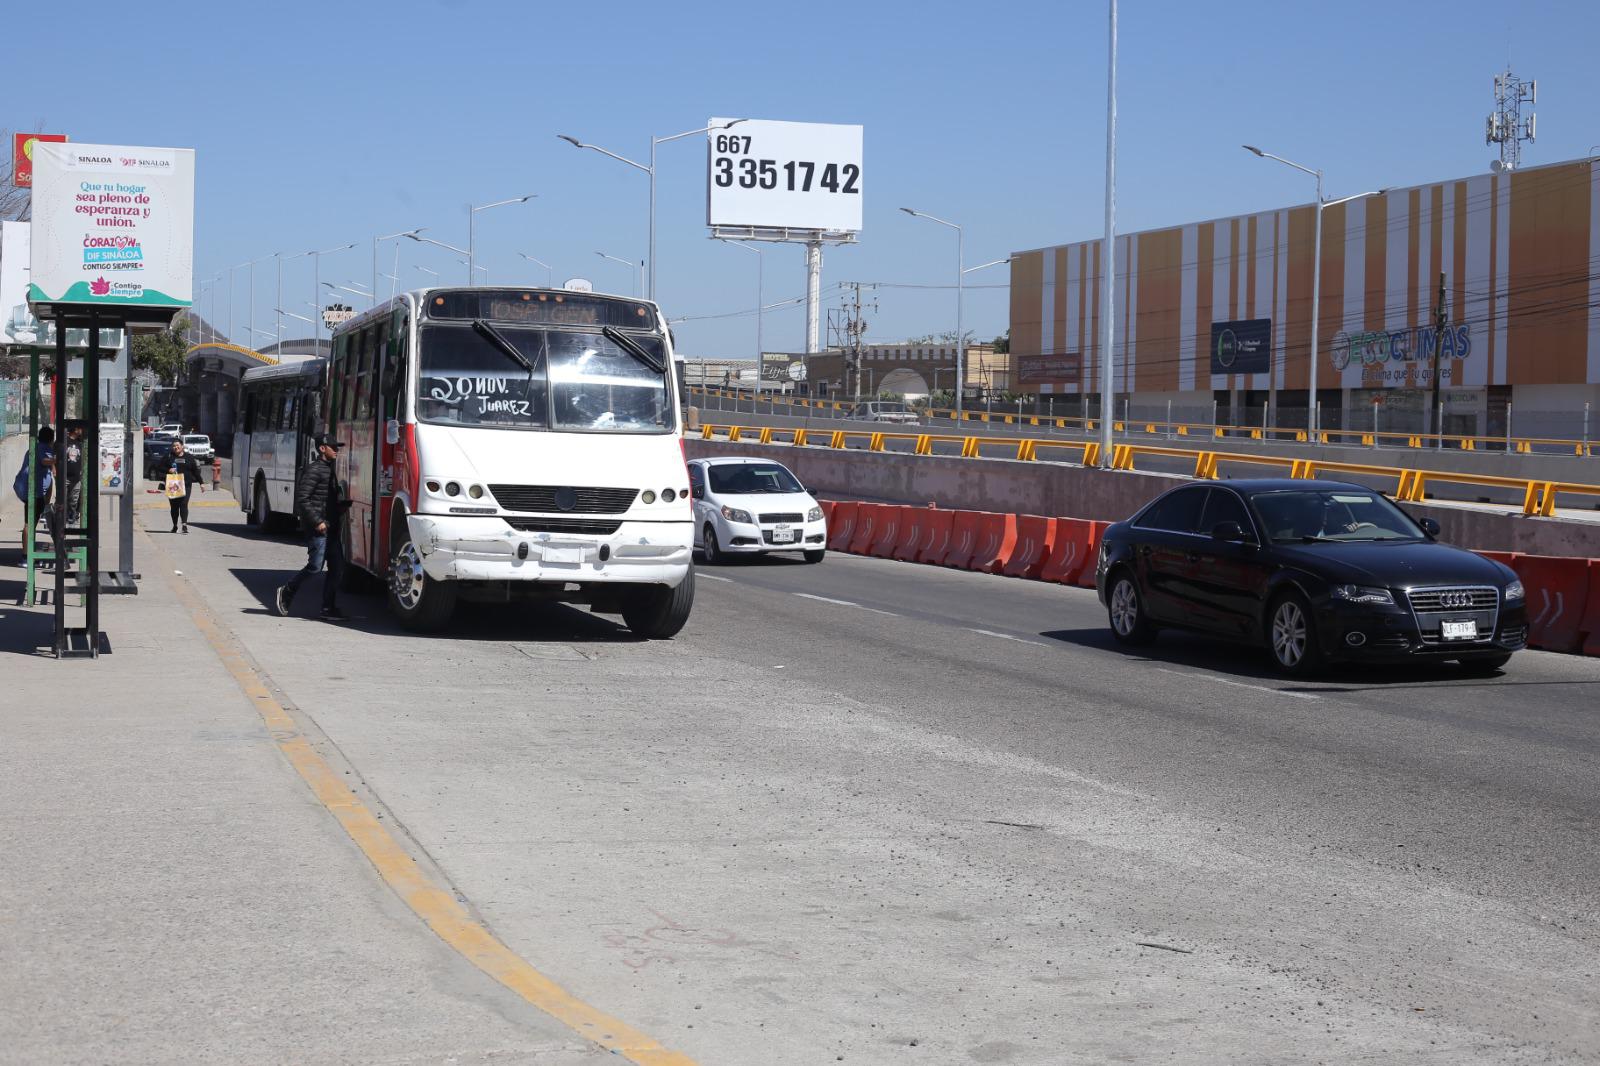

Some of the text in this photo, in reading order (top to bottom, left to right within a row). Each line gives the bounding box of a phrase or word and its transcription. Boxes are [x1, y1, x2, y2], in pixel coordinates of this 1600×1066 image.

[716, 135, 751, 155] 667
[138, 159, 170, 167] SINALOA
[80, 181, 146, 194] Que tu hogar
[76, 192, 150, 204] sea pleno de
[75, 204, 151, 219] esperanza y
[87, 250, 140, 260] DIF SINALOA
[82, 262, 138, 271] CONTIGO SIEMPRE
[114, 282, 142, 290] Contigo
[1350, 325, 1471, 364] ECOCLIMAS
[476, 378, 509, 394] NOV.
